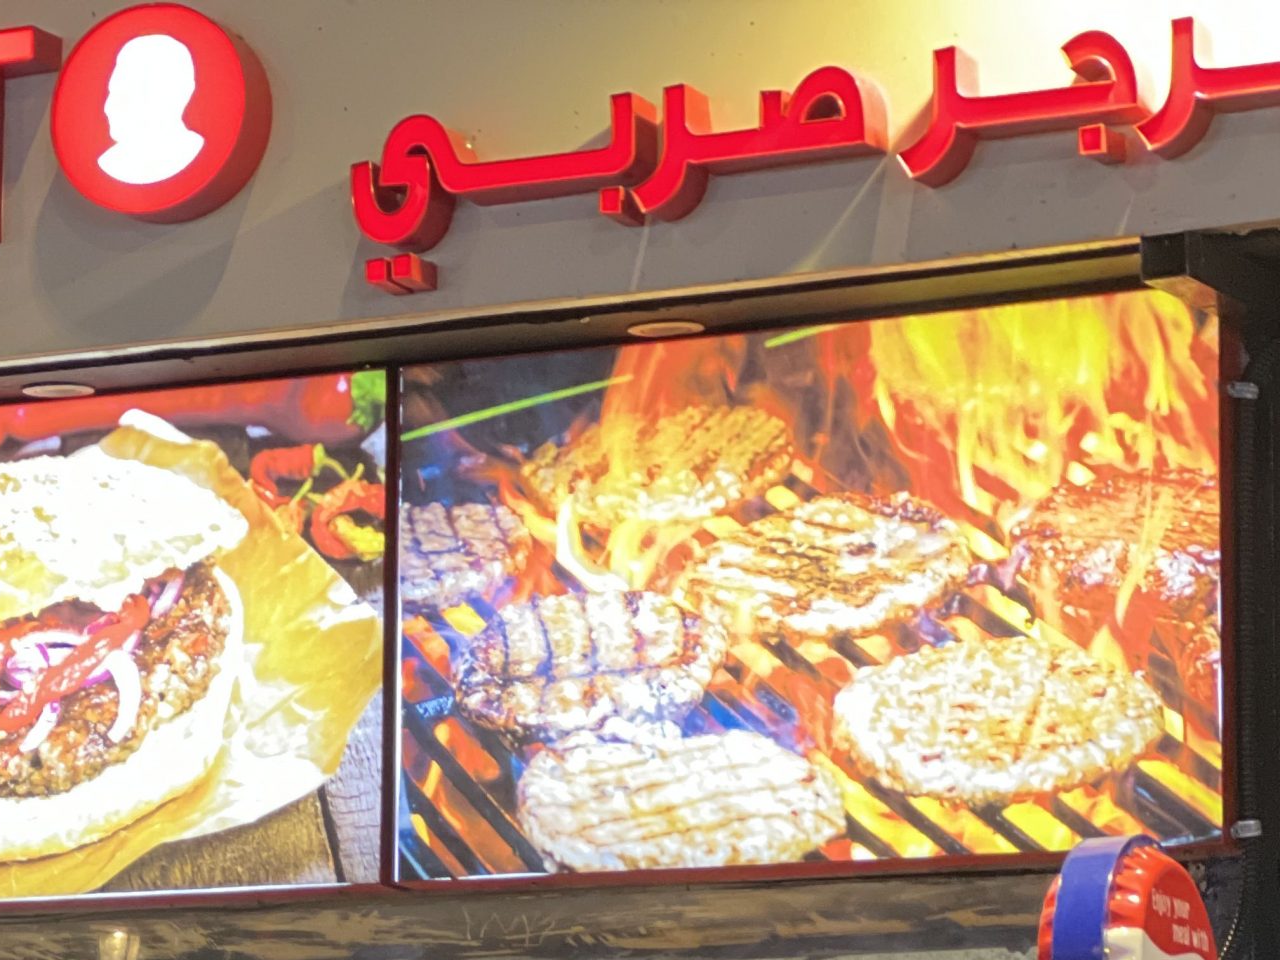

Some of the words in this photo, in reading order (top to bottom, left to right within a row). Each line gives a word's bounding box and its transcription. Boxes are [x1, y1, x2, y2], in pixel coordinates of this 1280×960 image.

[350, 64, 886, 294] صربي
[1152, 888, 1171, 918] Enjoy
[1172, 896, 1191, 920] your
[1172, 922, 1191, 946] meal
[1191, 928, 1210, 953] with
